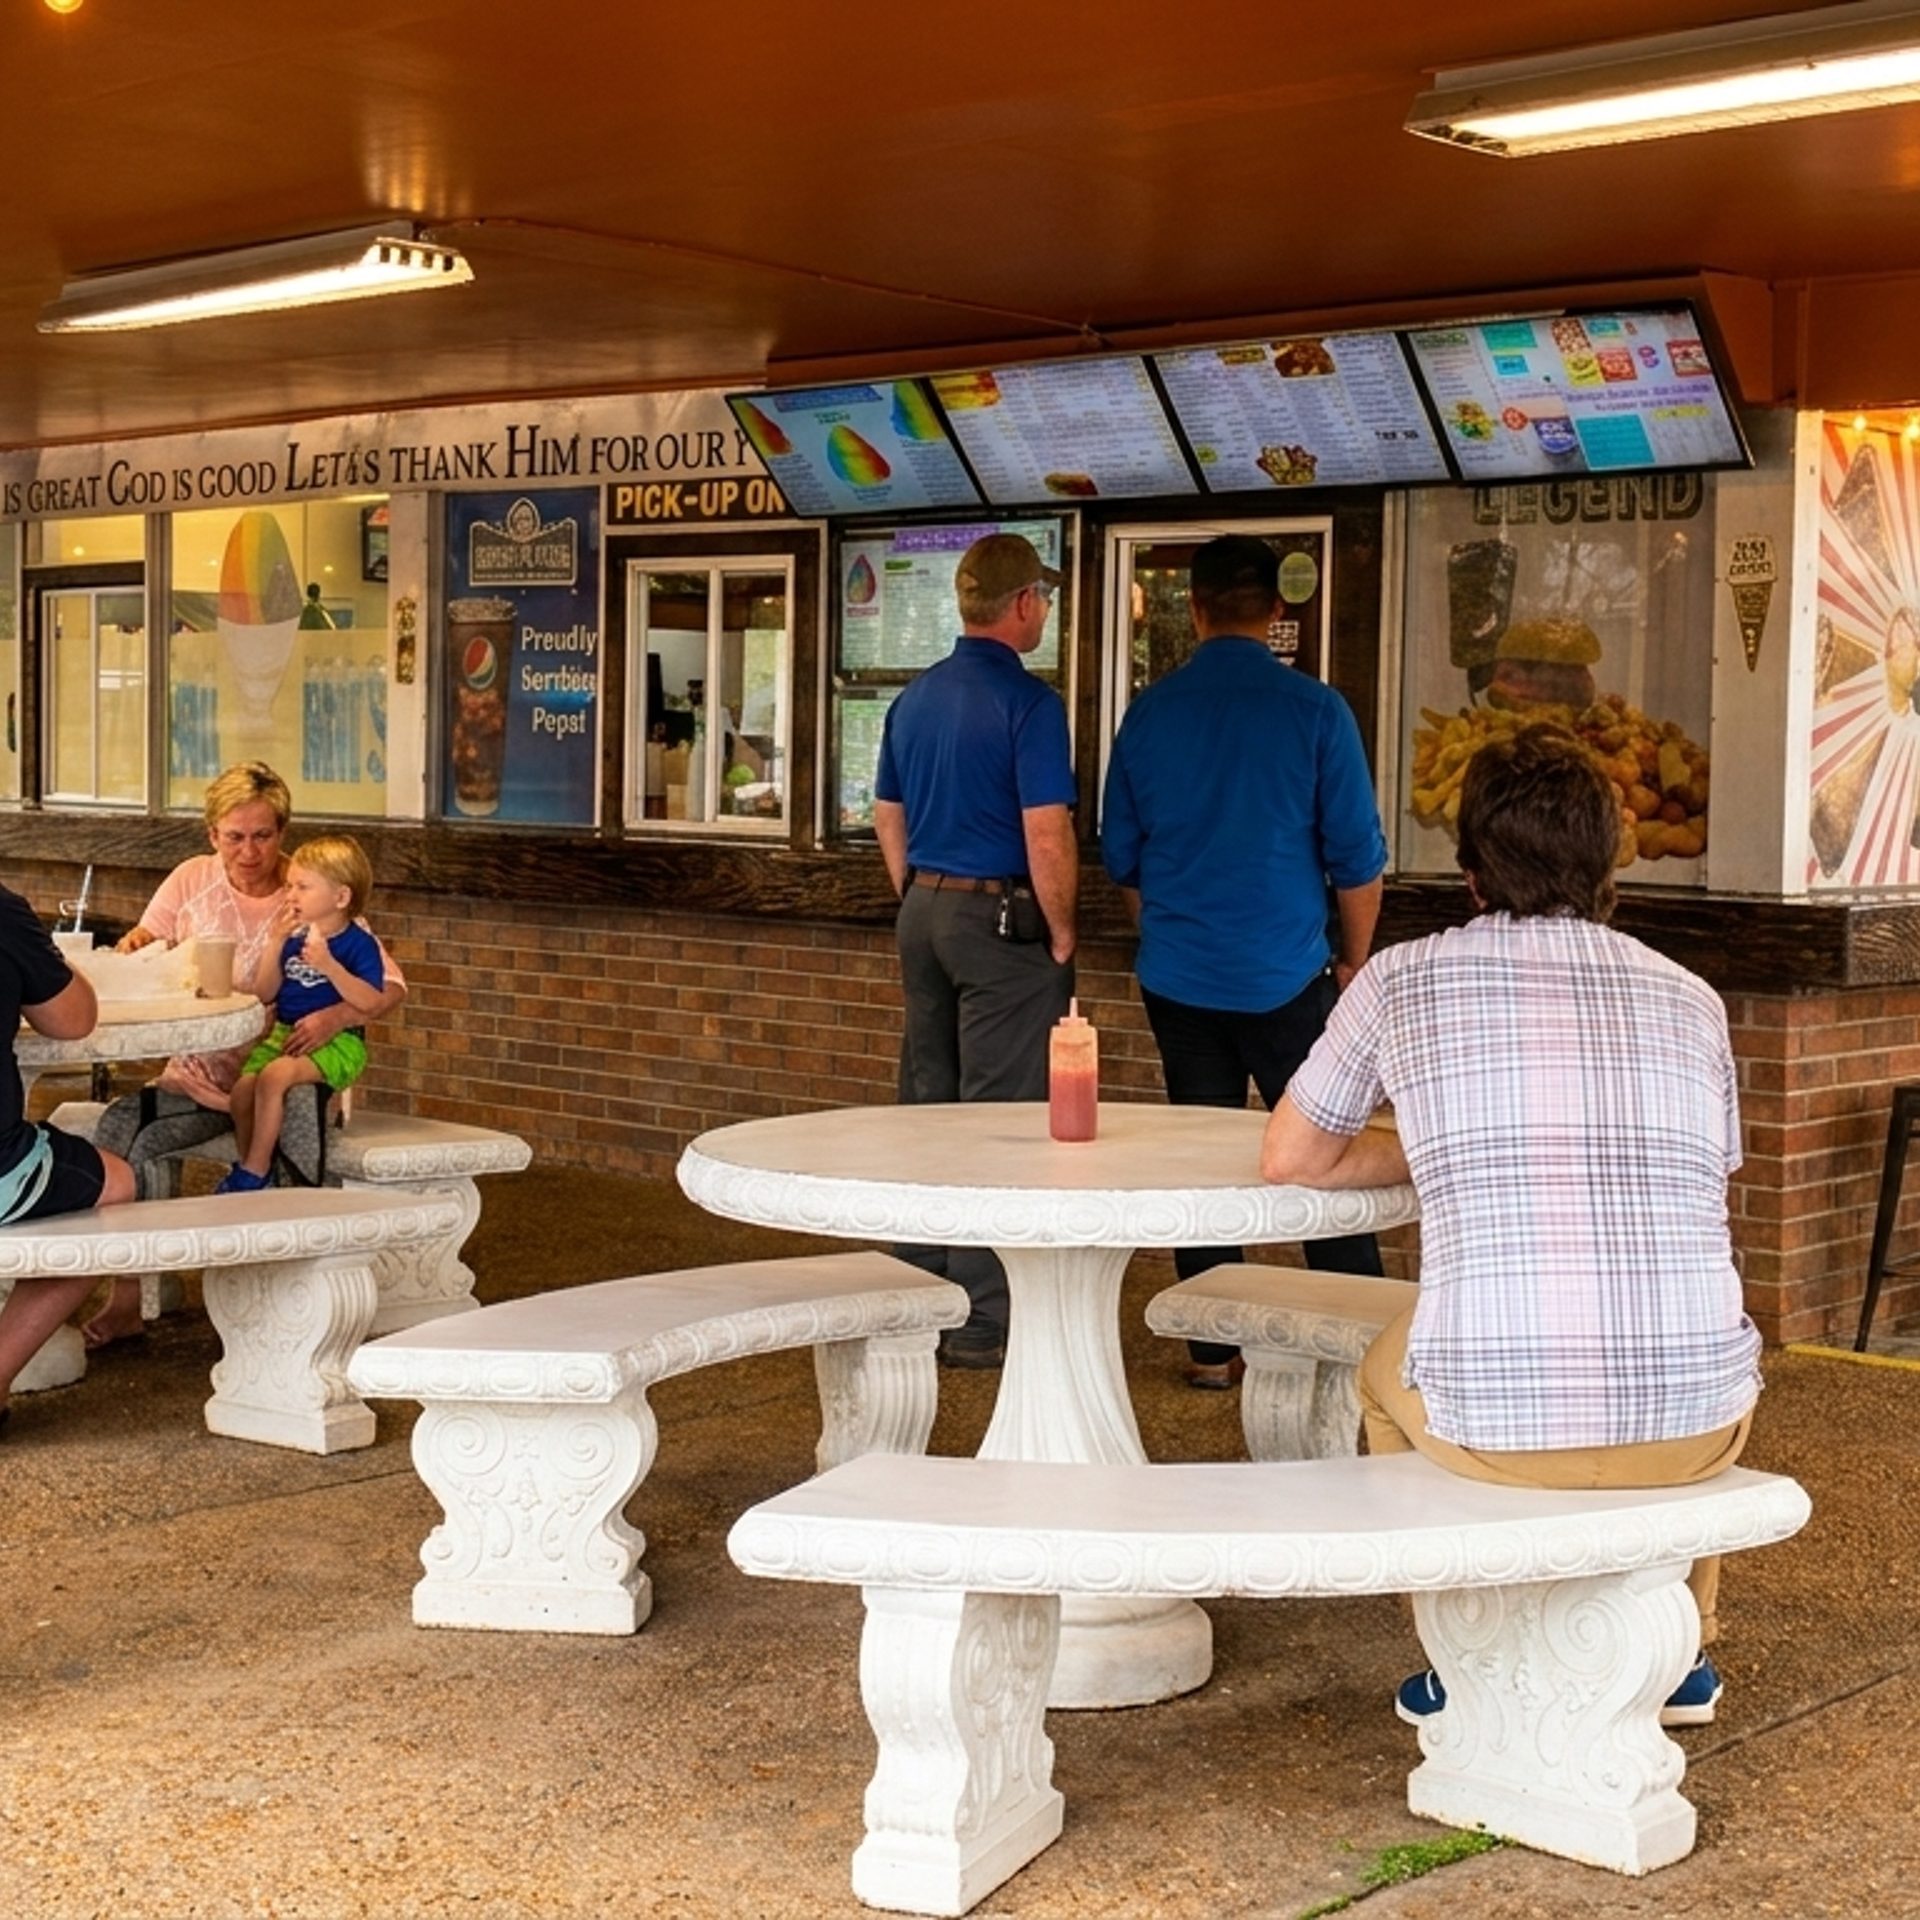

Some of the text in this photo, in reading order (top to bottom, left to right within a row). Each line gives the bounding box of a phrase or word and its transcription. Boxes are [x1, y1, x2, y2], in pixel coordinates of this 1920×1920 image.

[2, 482, 21, 515] IS
[27, 475, 101, 513] GREAT
[107, 459, 166, 506] GOD
[172, 468, 193, 501] IS
[198, 461, 276, 498] GOOD
[389, 441, 499, 483] THANK
[504, 424, 581, 479] HIM
[589, 435, 649, 475] FOR
[655, 430, 726, 469] OUR
[615, 480, 739, 519] PICK-UP
